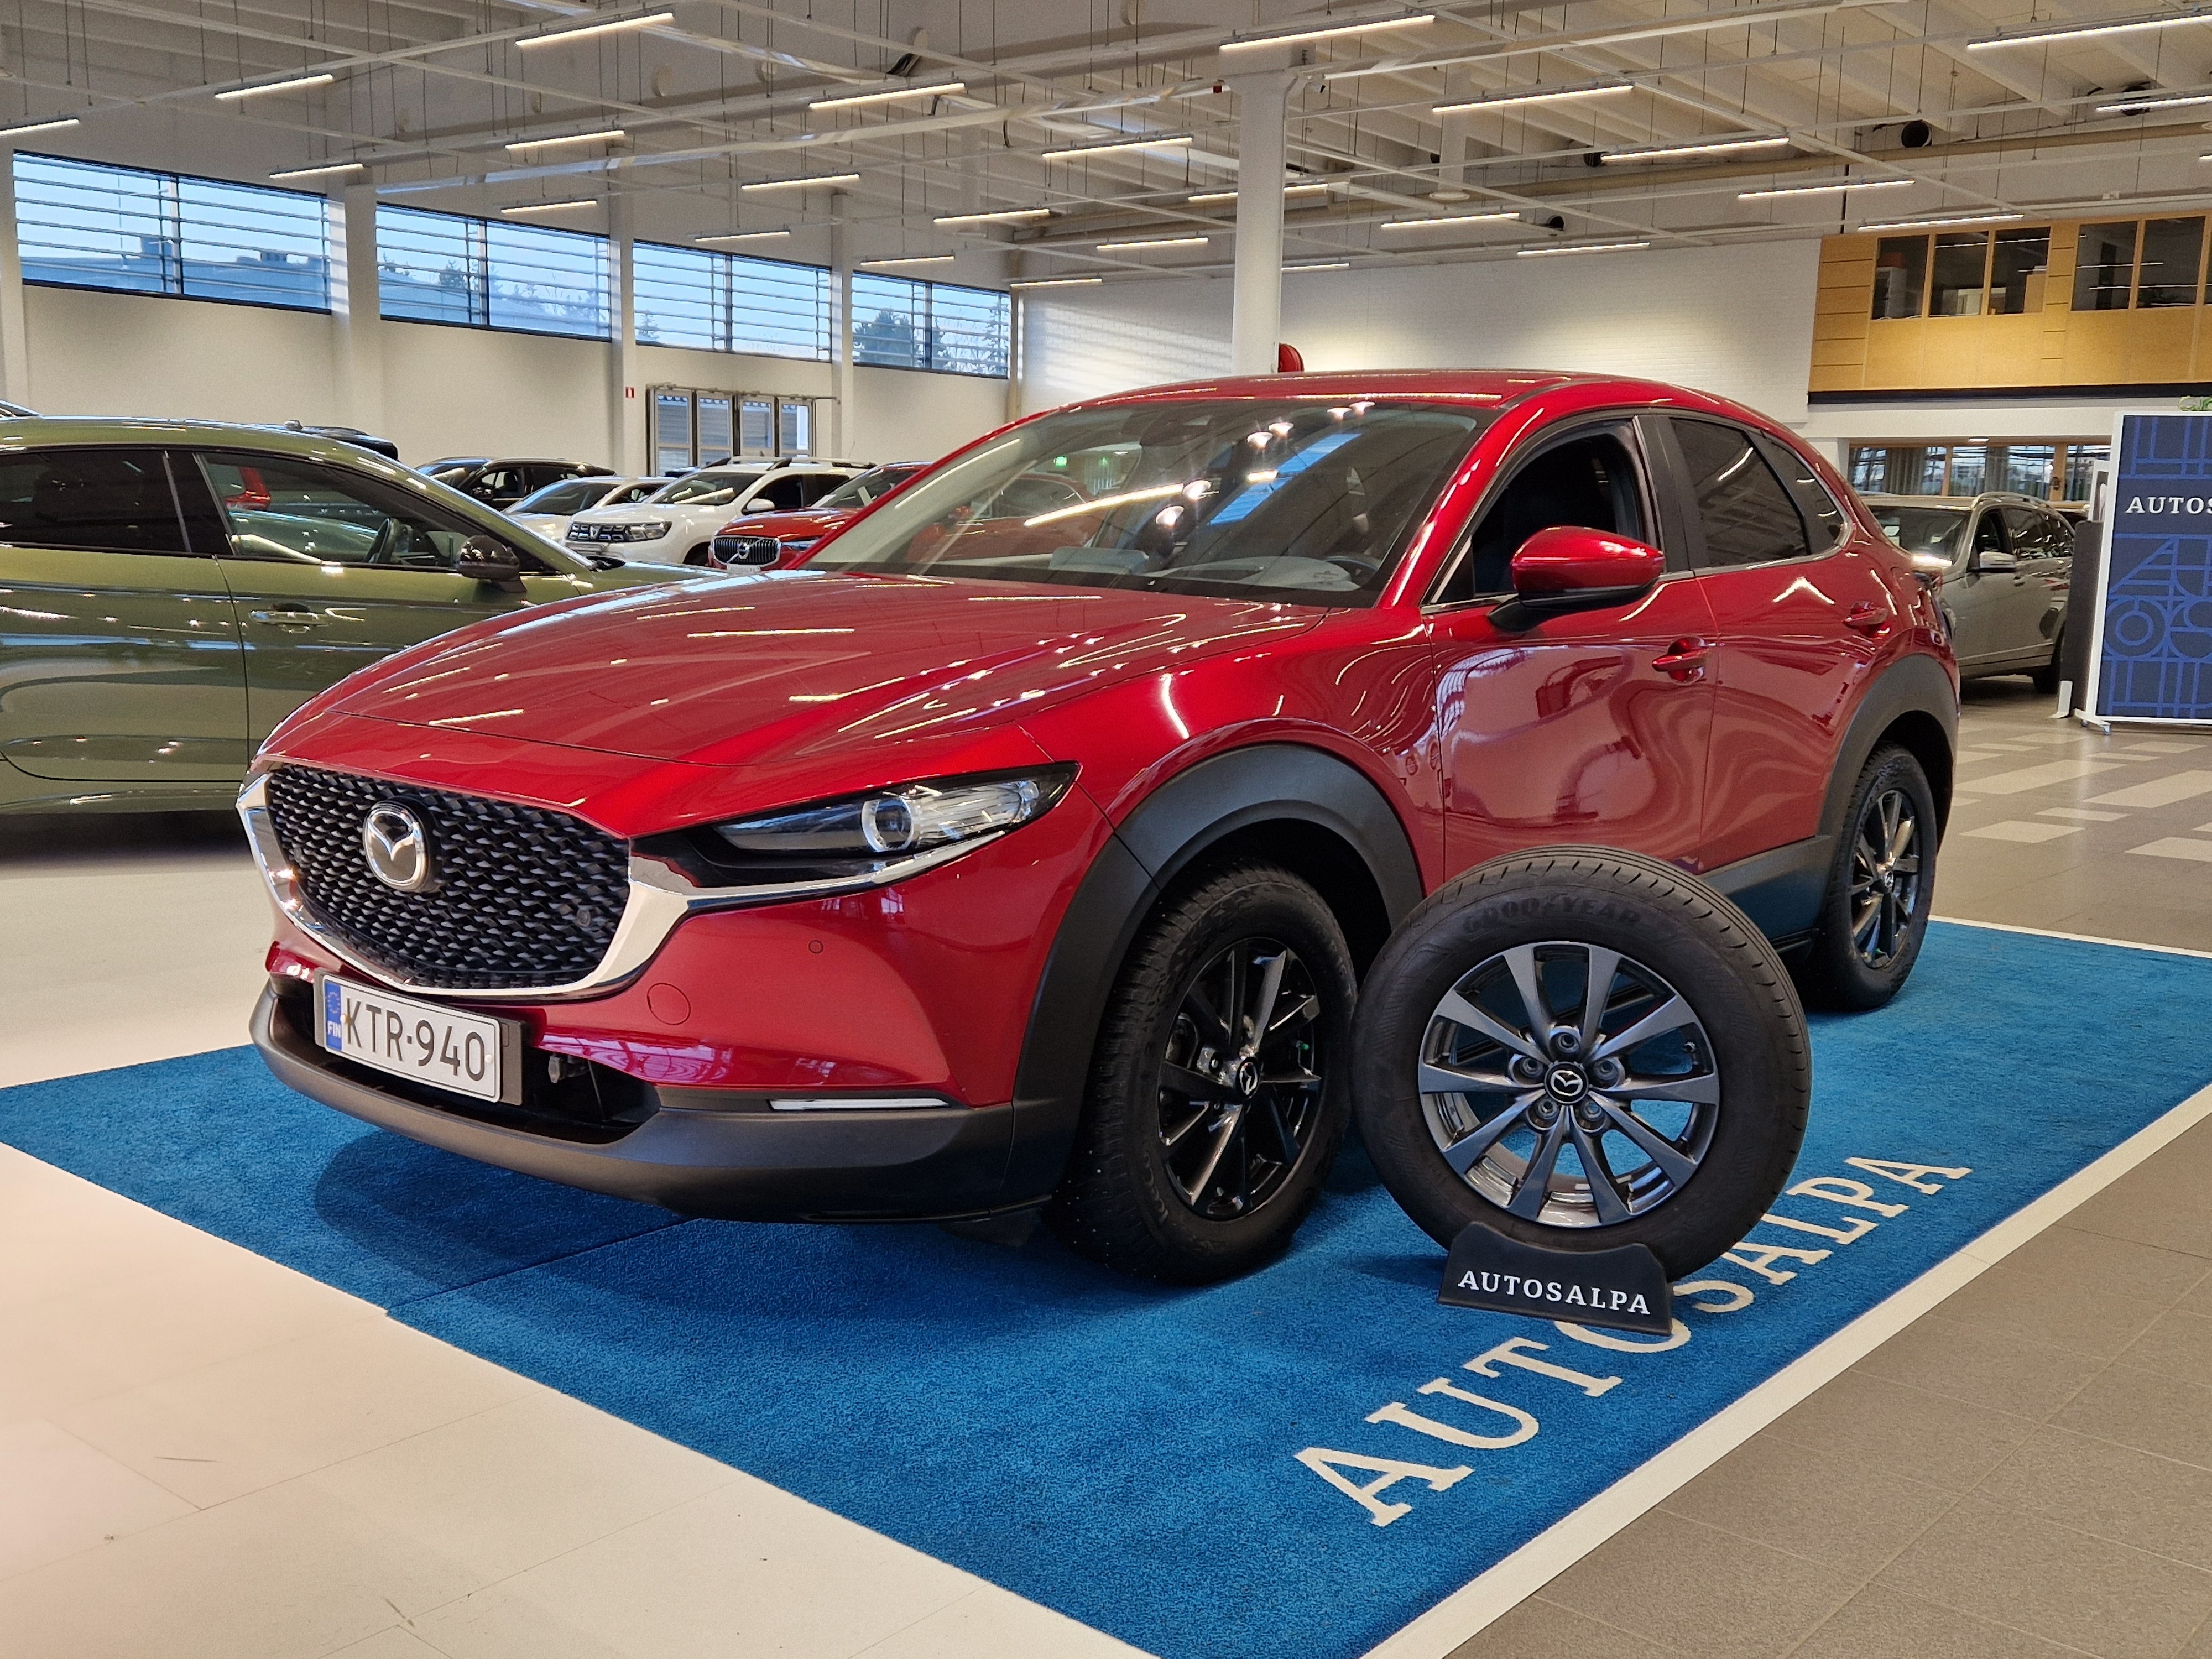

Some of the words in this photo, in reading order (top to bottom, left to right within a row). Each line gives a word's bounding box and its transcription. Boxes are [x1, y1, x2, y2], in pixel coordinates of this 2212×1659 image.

[327, 1020, 341, 1038] FIN
[346, 998, 485, 1081] KTR-940
[1457, 1270, 1651, 1315] AUTOSALPA
